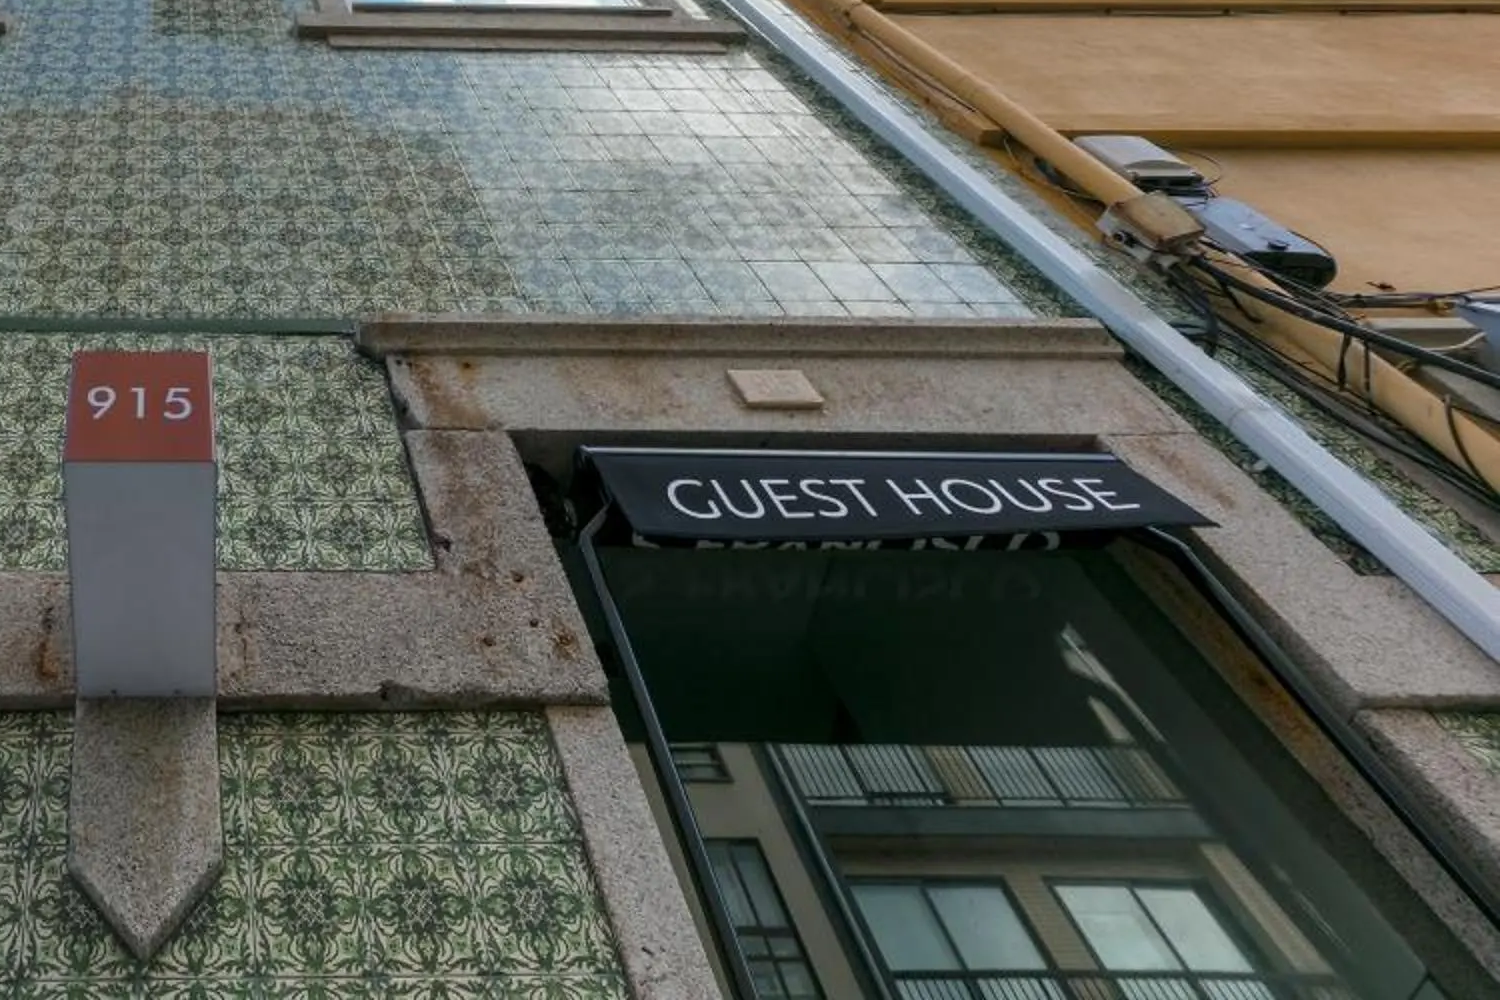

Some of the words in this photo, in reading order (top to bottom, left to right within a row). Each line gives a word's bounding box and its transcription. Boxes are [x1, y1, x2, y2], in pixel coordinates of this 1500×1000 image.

[87, 385, 193, 420] 915
[667, 478, 879, 519] GUEST
[885, 478, 1141, 514] HOUSE
